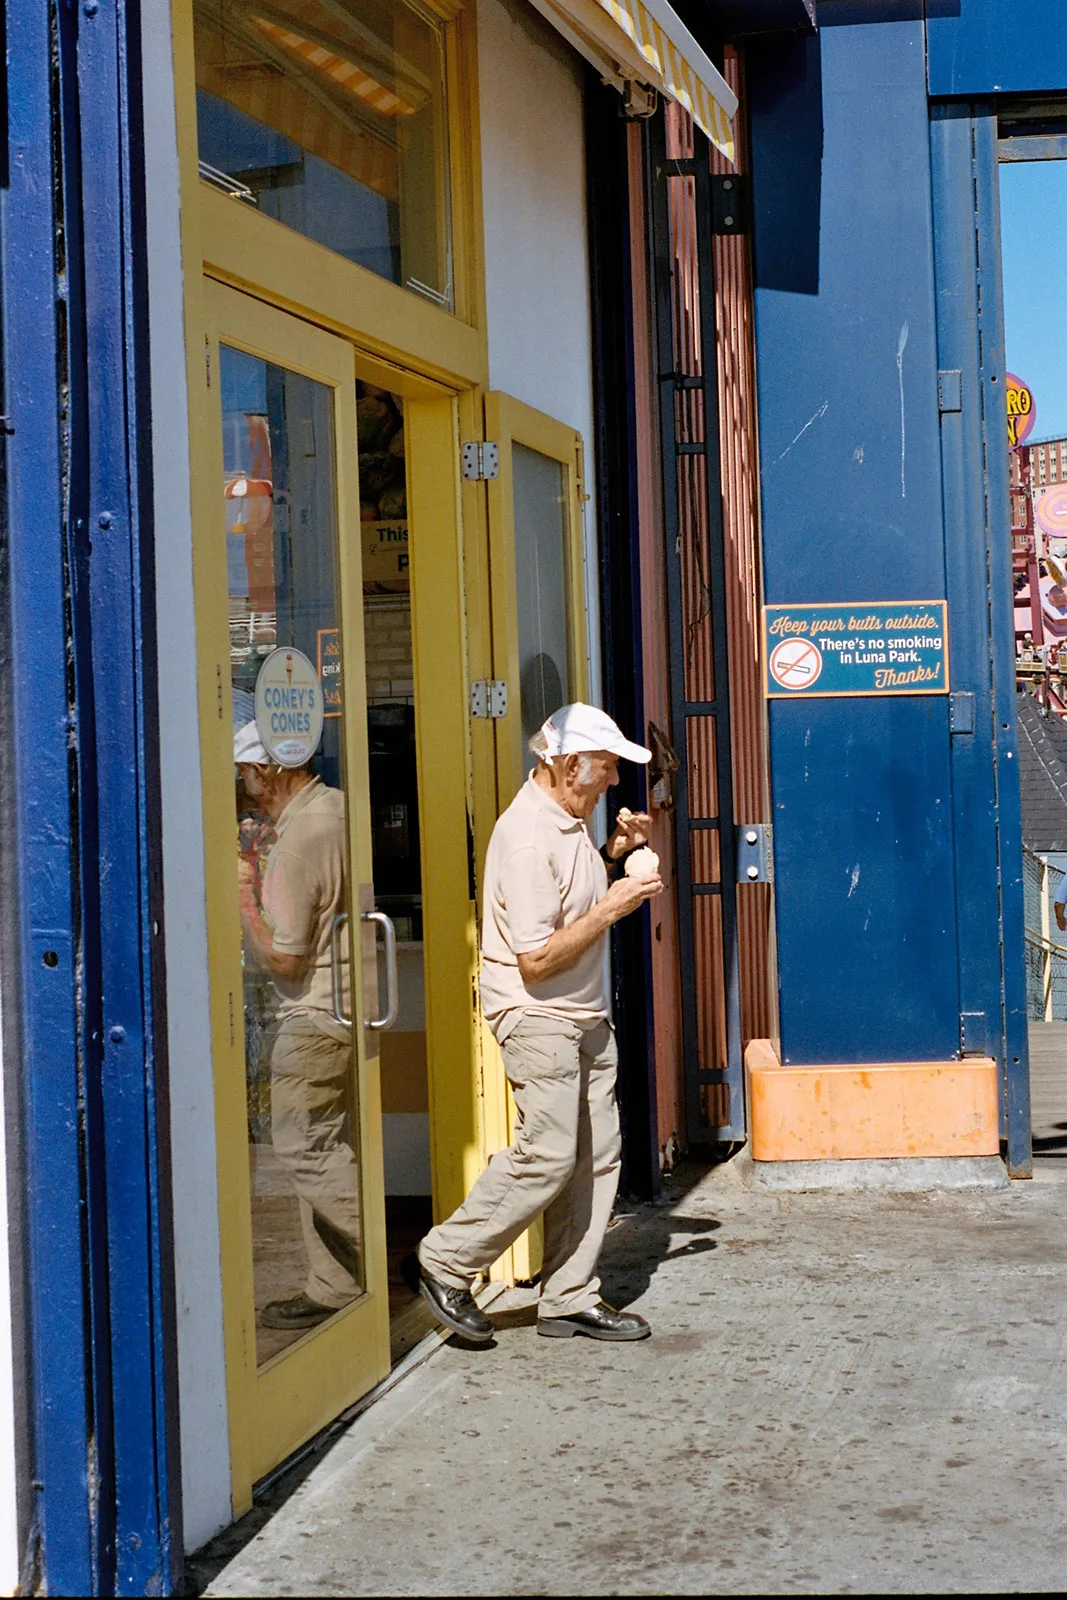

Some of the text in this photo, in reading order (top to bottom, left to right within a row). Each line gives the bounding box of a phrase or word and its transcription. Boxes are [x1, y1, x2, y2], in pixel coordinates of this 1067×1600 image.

[376, 527, 408, 541] This
[769, 613, 939, 637] Keep your butts outside.
[819, 635, 942, 651] There's no smoking
[840, 650, 922, 664] in Luna Park.
[874, 662, 941, 689] Thanks!
[264, 687, 316, 710] CONEY'S
[271, 712, 311, 733] CONES
